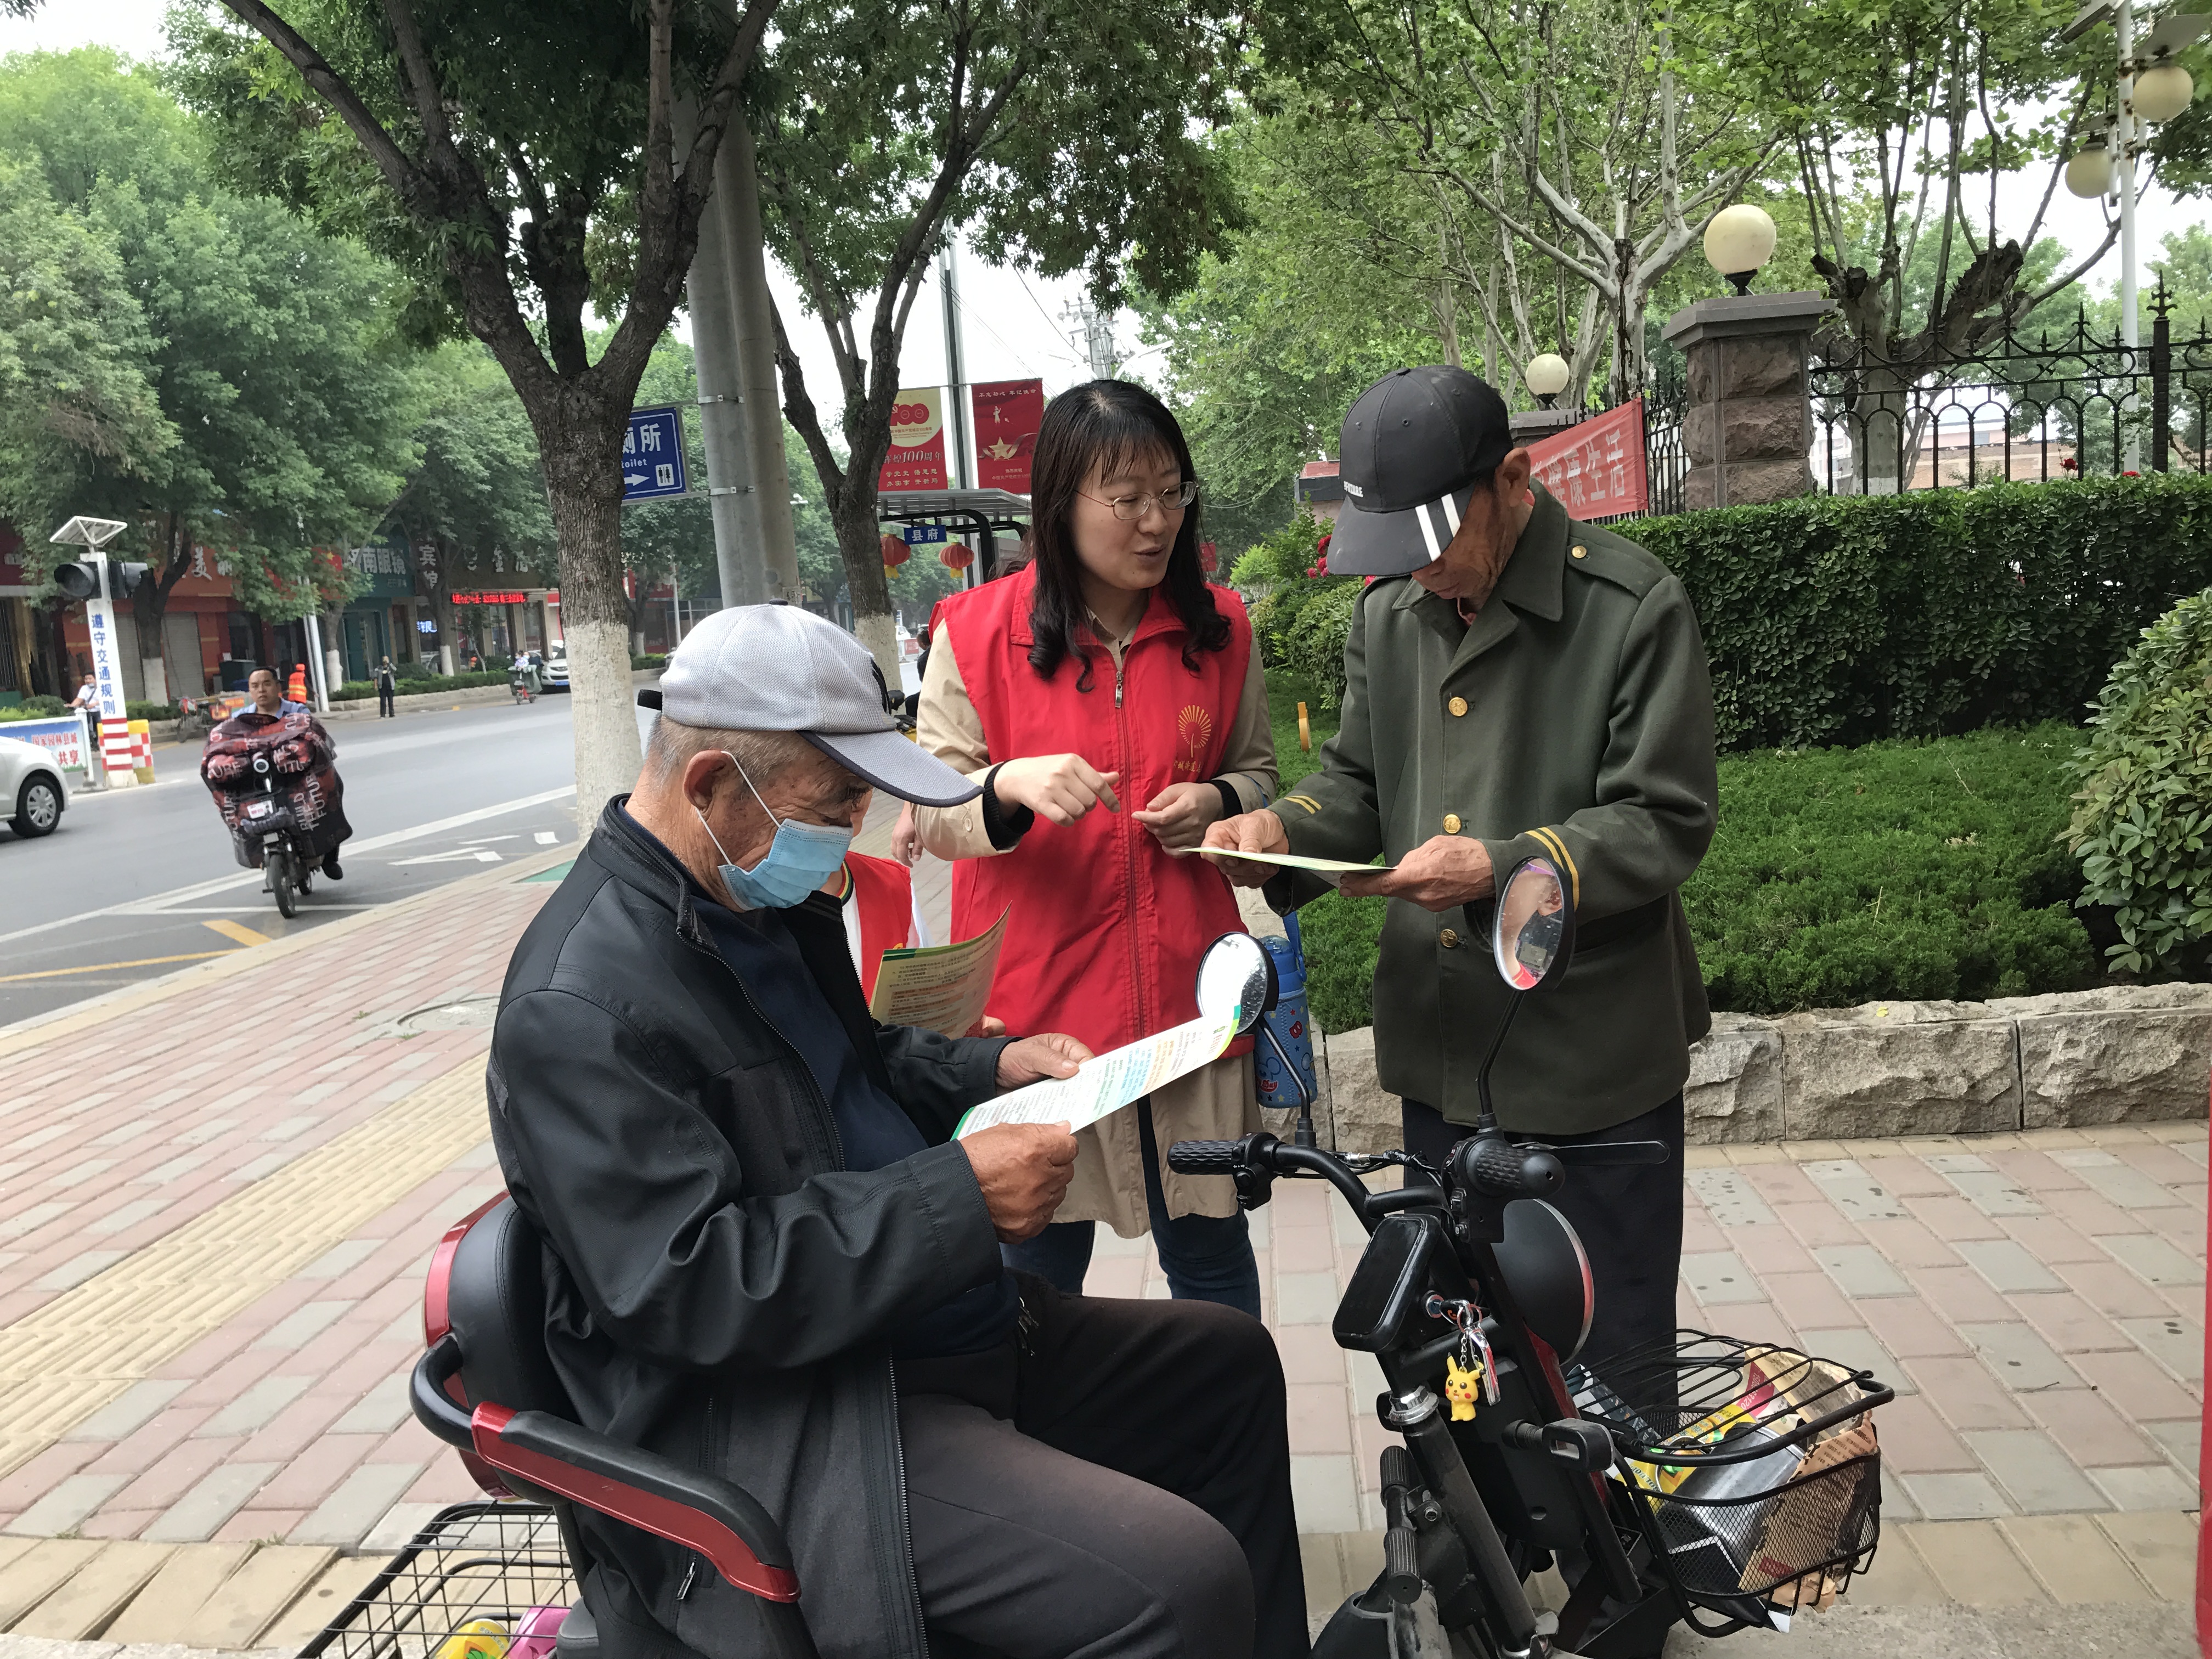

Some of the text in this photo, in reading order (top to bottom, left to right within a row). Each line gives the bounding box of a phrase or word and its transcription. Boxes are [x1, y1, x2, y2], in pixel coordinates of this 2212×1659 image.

[912, 528, 938, 541] 县府
[92, 613, 116, 714] 遵守交通规则
